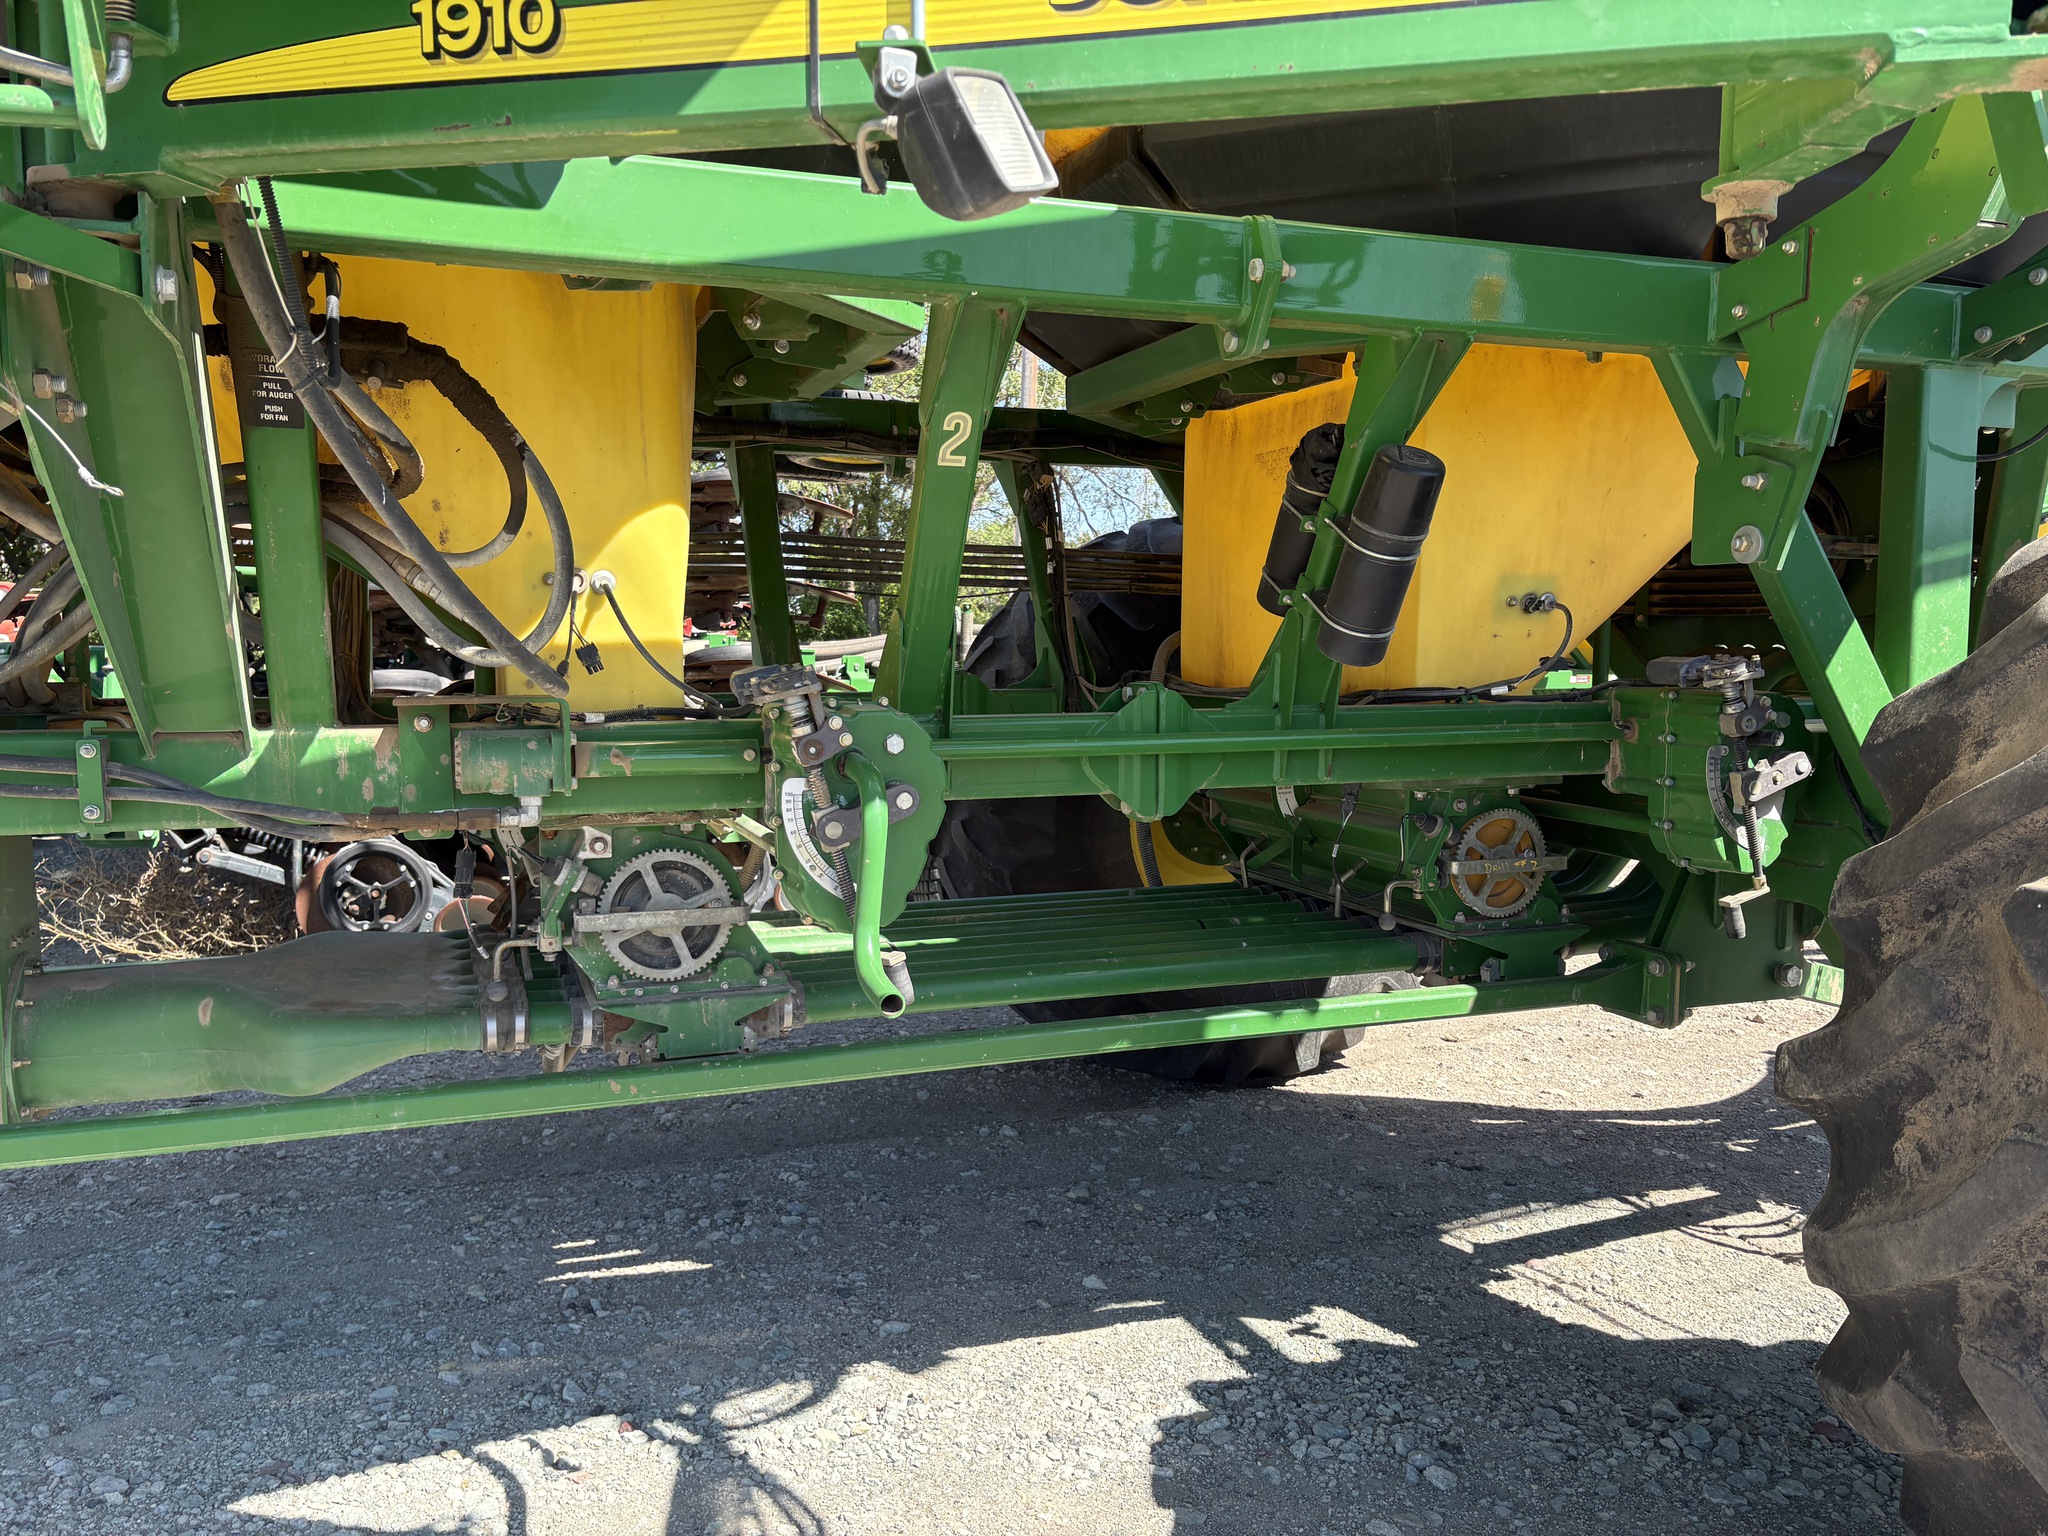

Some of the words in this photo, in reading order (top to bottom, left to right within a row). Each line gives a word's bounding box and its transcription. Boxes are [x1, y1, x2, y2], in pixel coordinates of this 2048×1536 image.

[411, 0, 560, 60] 1910
[262, 381, 282, 390] PULL
[252, 390, 267, 398] FOR
[269, 391, 294, 400] AUGER
[264, 404, 284, 413] PUSH
[260, 413, 274, 421] FOR
[275, 414, 289, 422] FAN
[937, 411, 972, 467] 2
